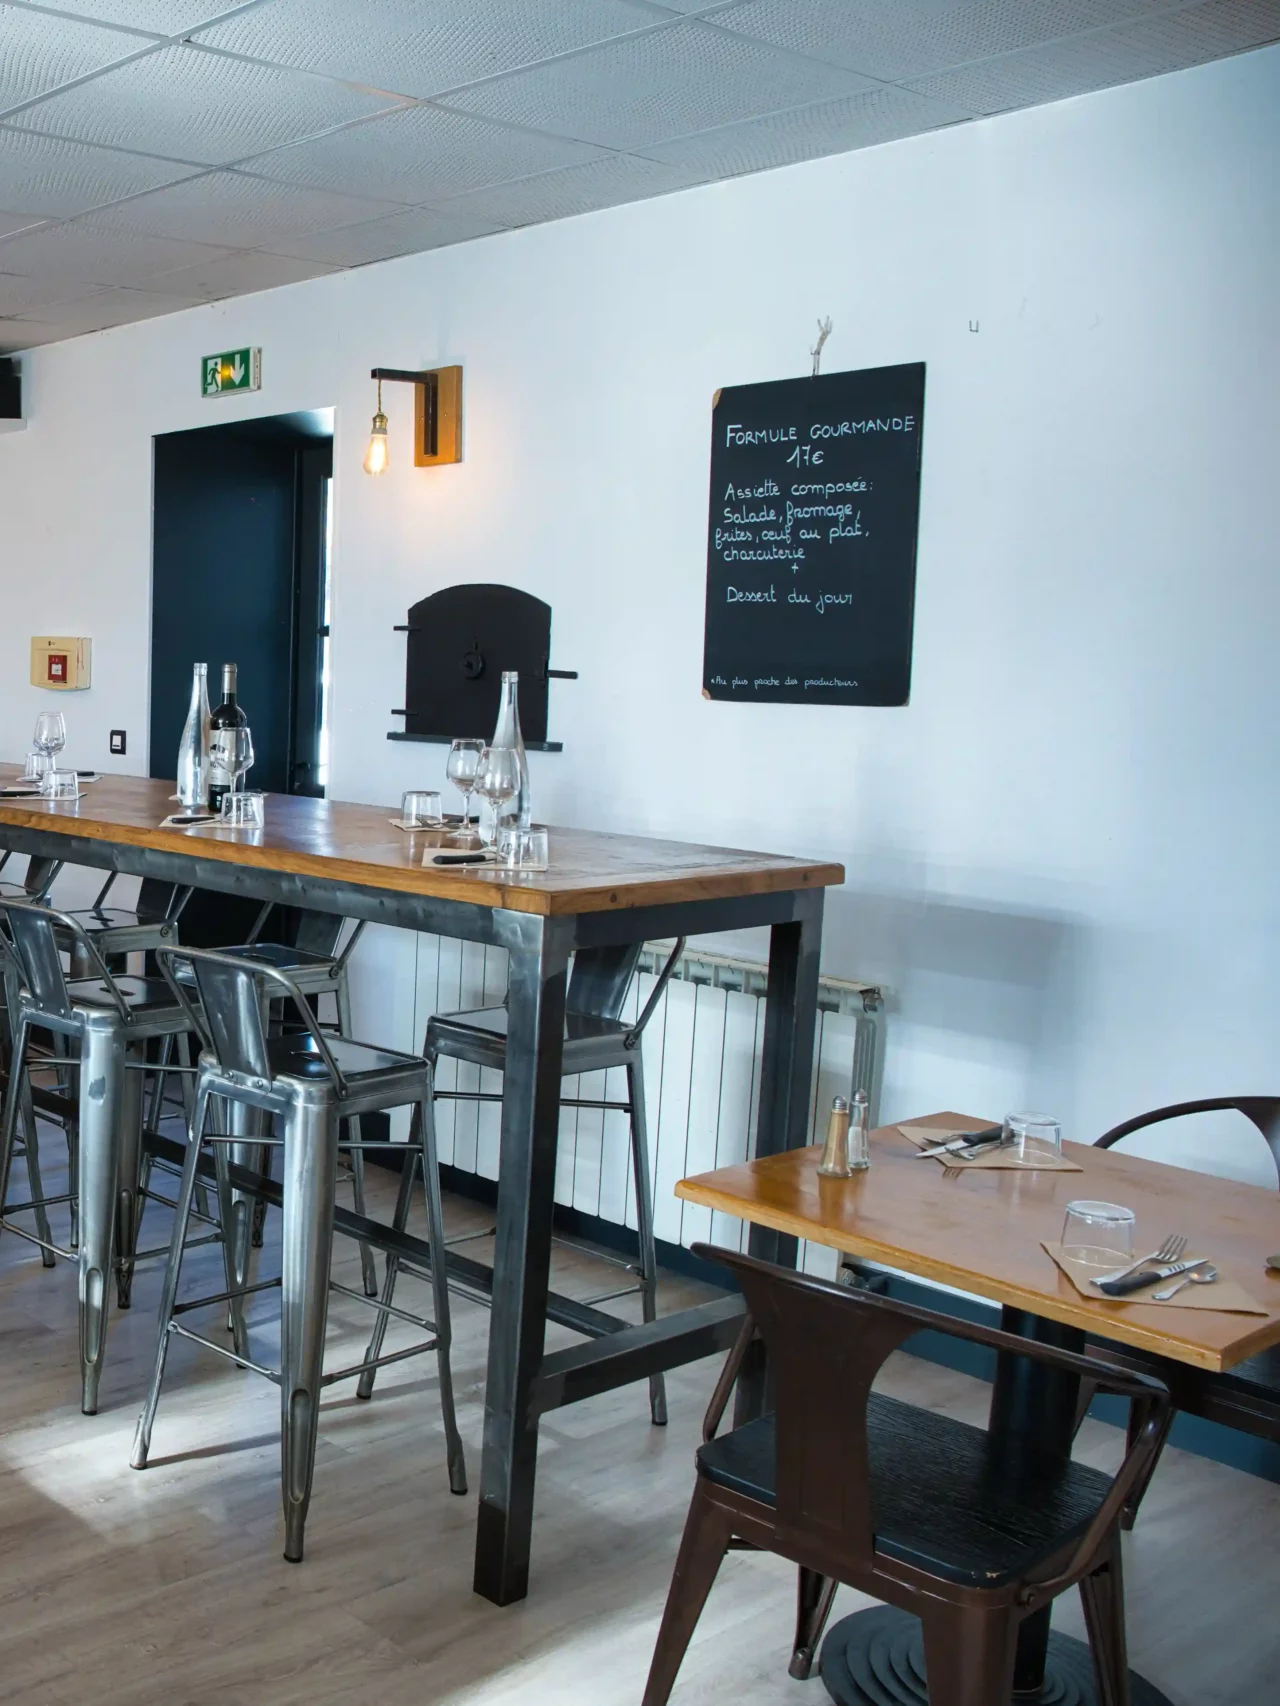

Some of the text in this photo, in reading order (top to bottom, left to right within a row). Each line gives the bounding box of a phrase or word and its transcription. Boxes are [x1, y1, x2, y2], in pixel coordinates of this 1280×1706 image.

[726, 415, 915, 447] FORMULE GOURMANDE
[786, 444, 824, 468] 17€
[724, 479, 781, 501] Assiette
[799, 529, 821, 540] au
[723, 545, 806, 562] charcuterie
[726, 584, 853, 614] Dessert du jour
[732, 676, 748, 689] plus
[754, 676, 780, 689] proche
[785, 676, 798, 686] des
